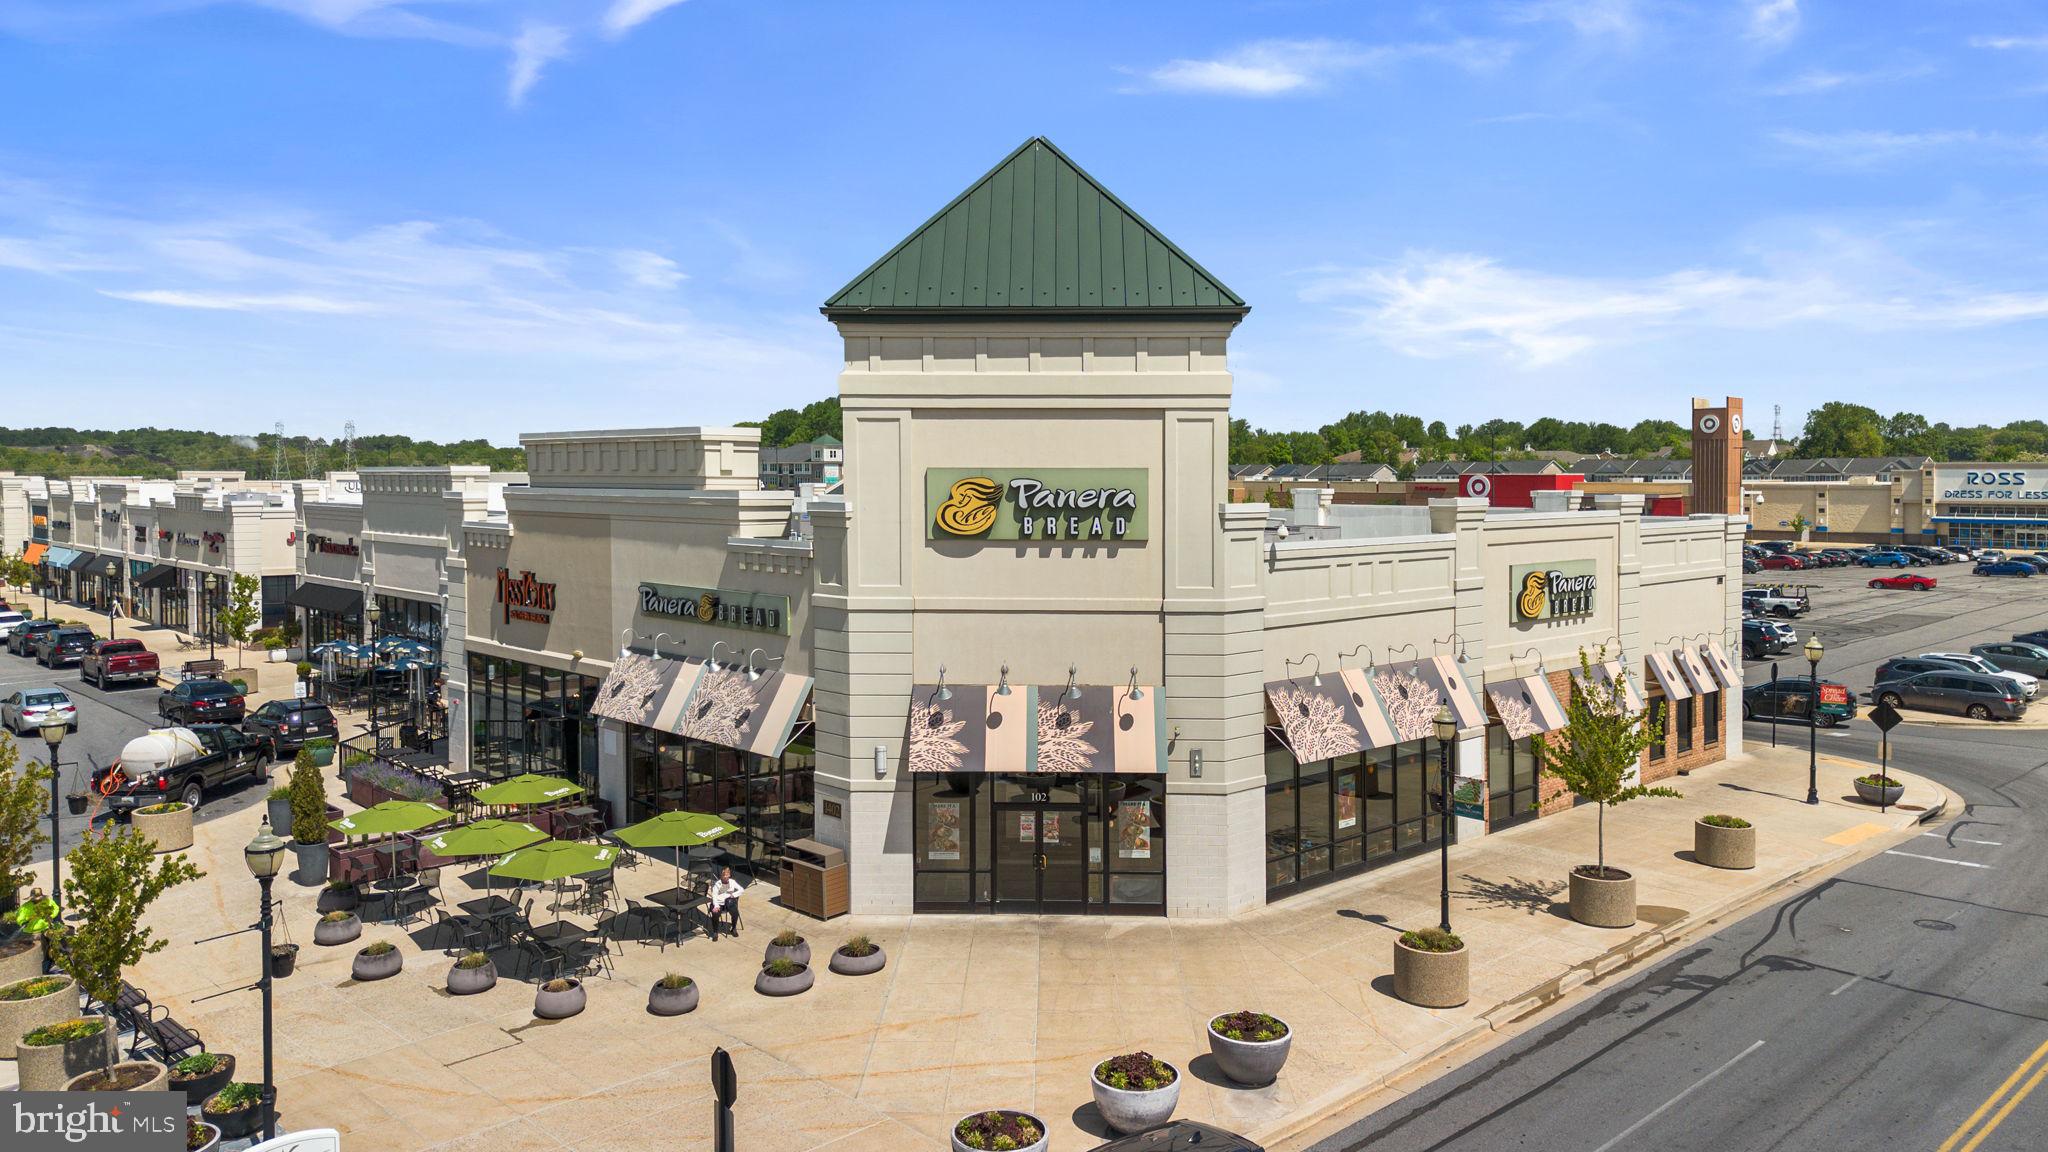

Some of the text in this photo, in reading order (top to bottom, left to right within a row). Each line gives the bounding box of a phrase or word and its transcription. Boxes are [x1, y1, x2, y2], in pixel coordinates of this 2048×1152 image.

[1967, 472, 2025, 485] ROSS
[1010, 477, 1136, 509] Panera
[1944, 490, 2048, 500] DRESS FOR LESS
[1023, 516, 1127, 535] BREAD
[1549, 570, 1596, 594] Panera
[638, 586, 776, 627] Panera BREAD
[1553, 597, 1593, 615] BREAD
[1031, 793, 1047, 802] 102
